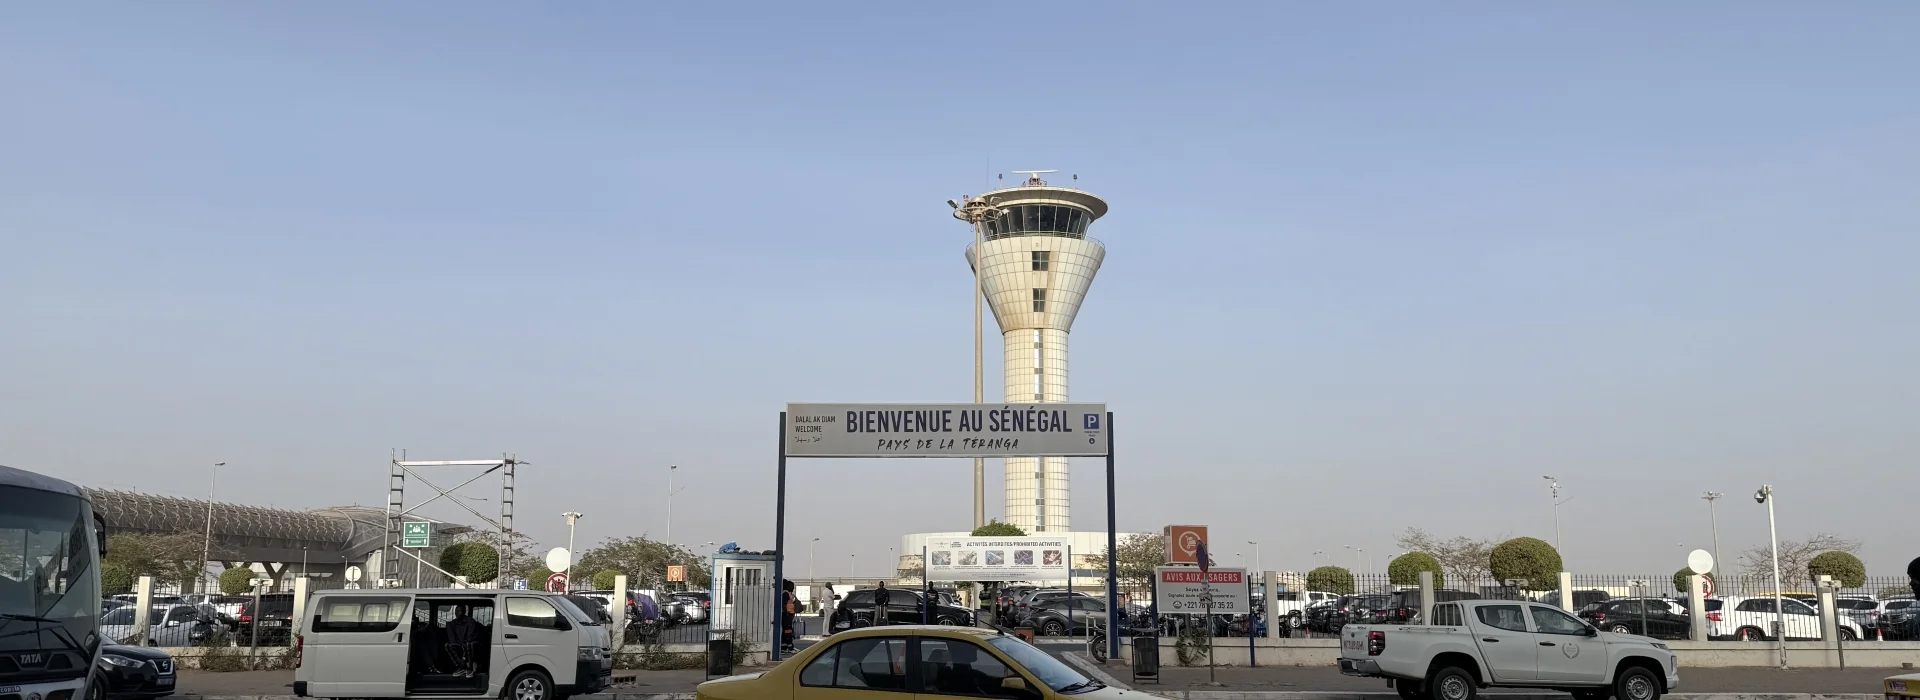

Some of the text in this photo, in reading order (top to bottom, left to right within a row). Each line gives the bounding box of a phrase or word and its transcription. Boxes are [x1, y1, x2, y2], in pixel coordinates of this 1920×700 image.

[795, 415, 836, 423] DALAL AK DIAM
[846, 406, 1072, 433] BIENVENUE AU SÉNÉGAL
[1087, 415, 1097, 428] P
[795, 425, 822, 433] WELCOME
[877, 436, 1019, 451] PAYS DE LA TÉRANGA
[1166, 572, 1183, 582] AVIS
[1186, 572, 1201, 582] AUX
[1184, 601, 1198, 609] +221
[1217, 601, 1226, 609] 35
[1226, 601, 1234, 609] 23
[21, 653, 41, 664] TATA
